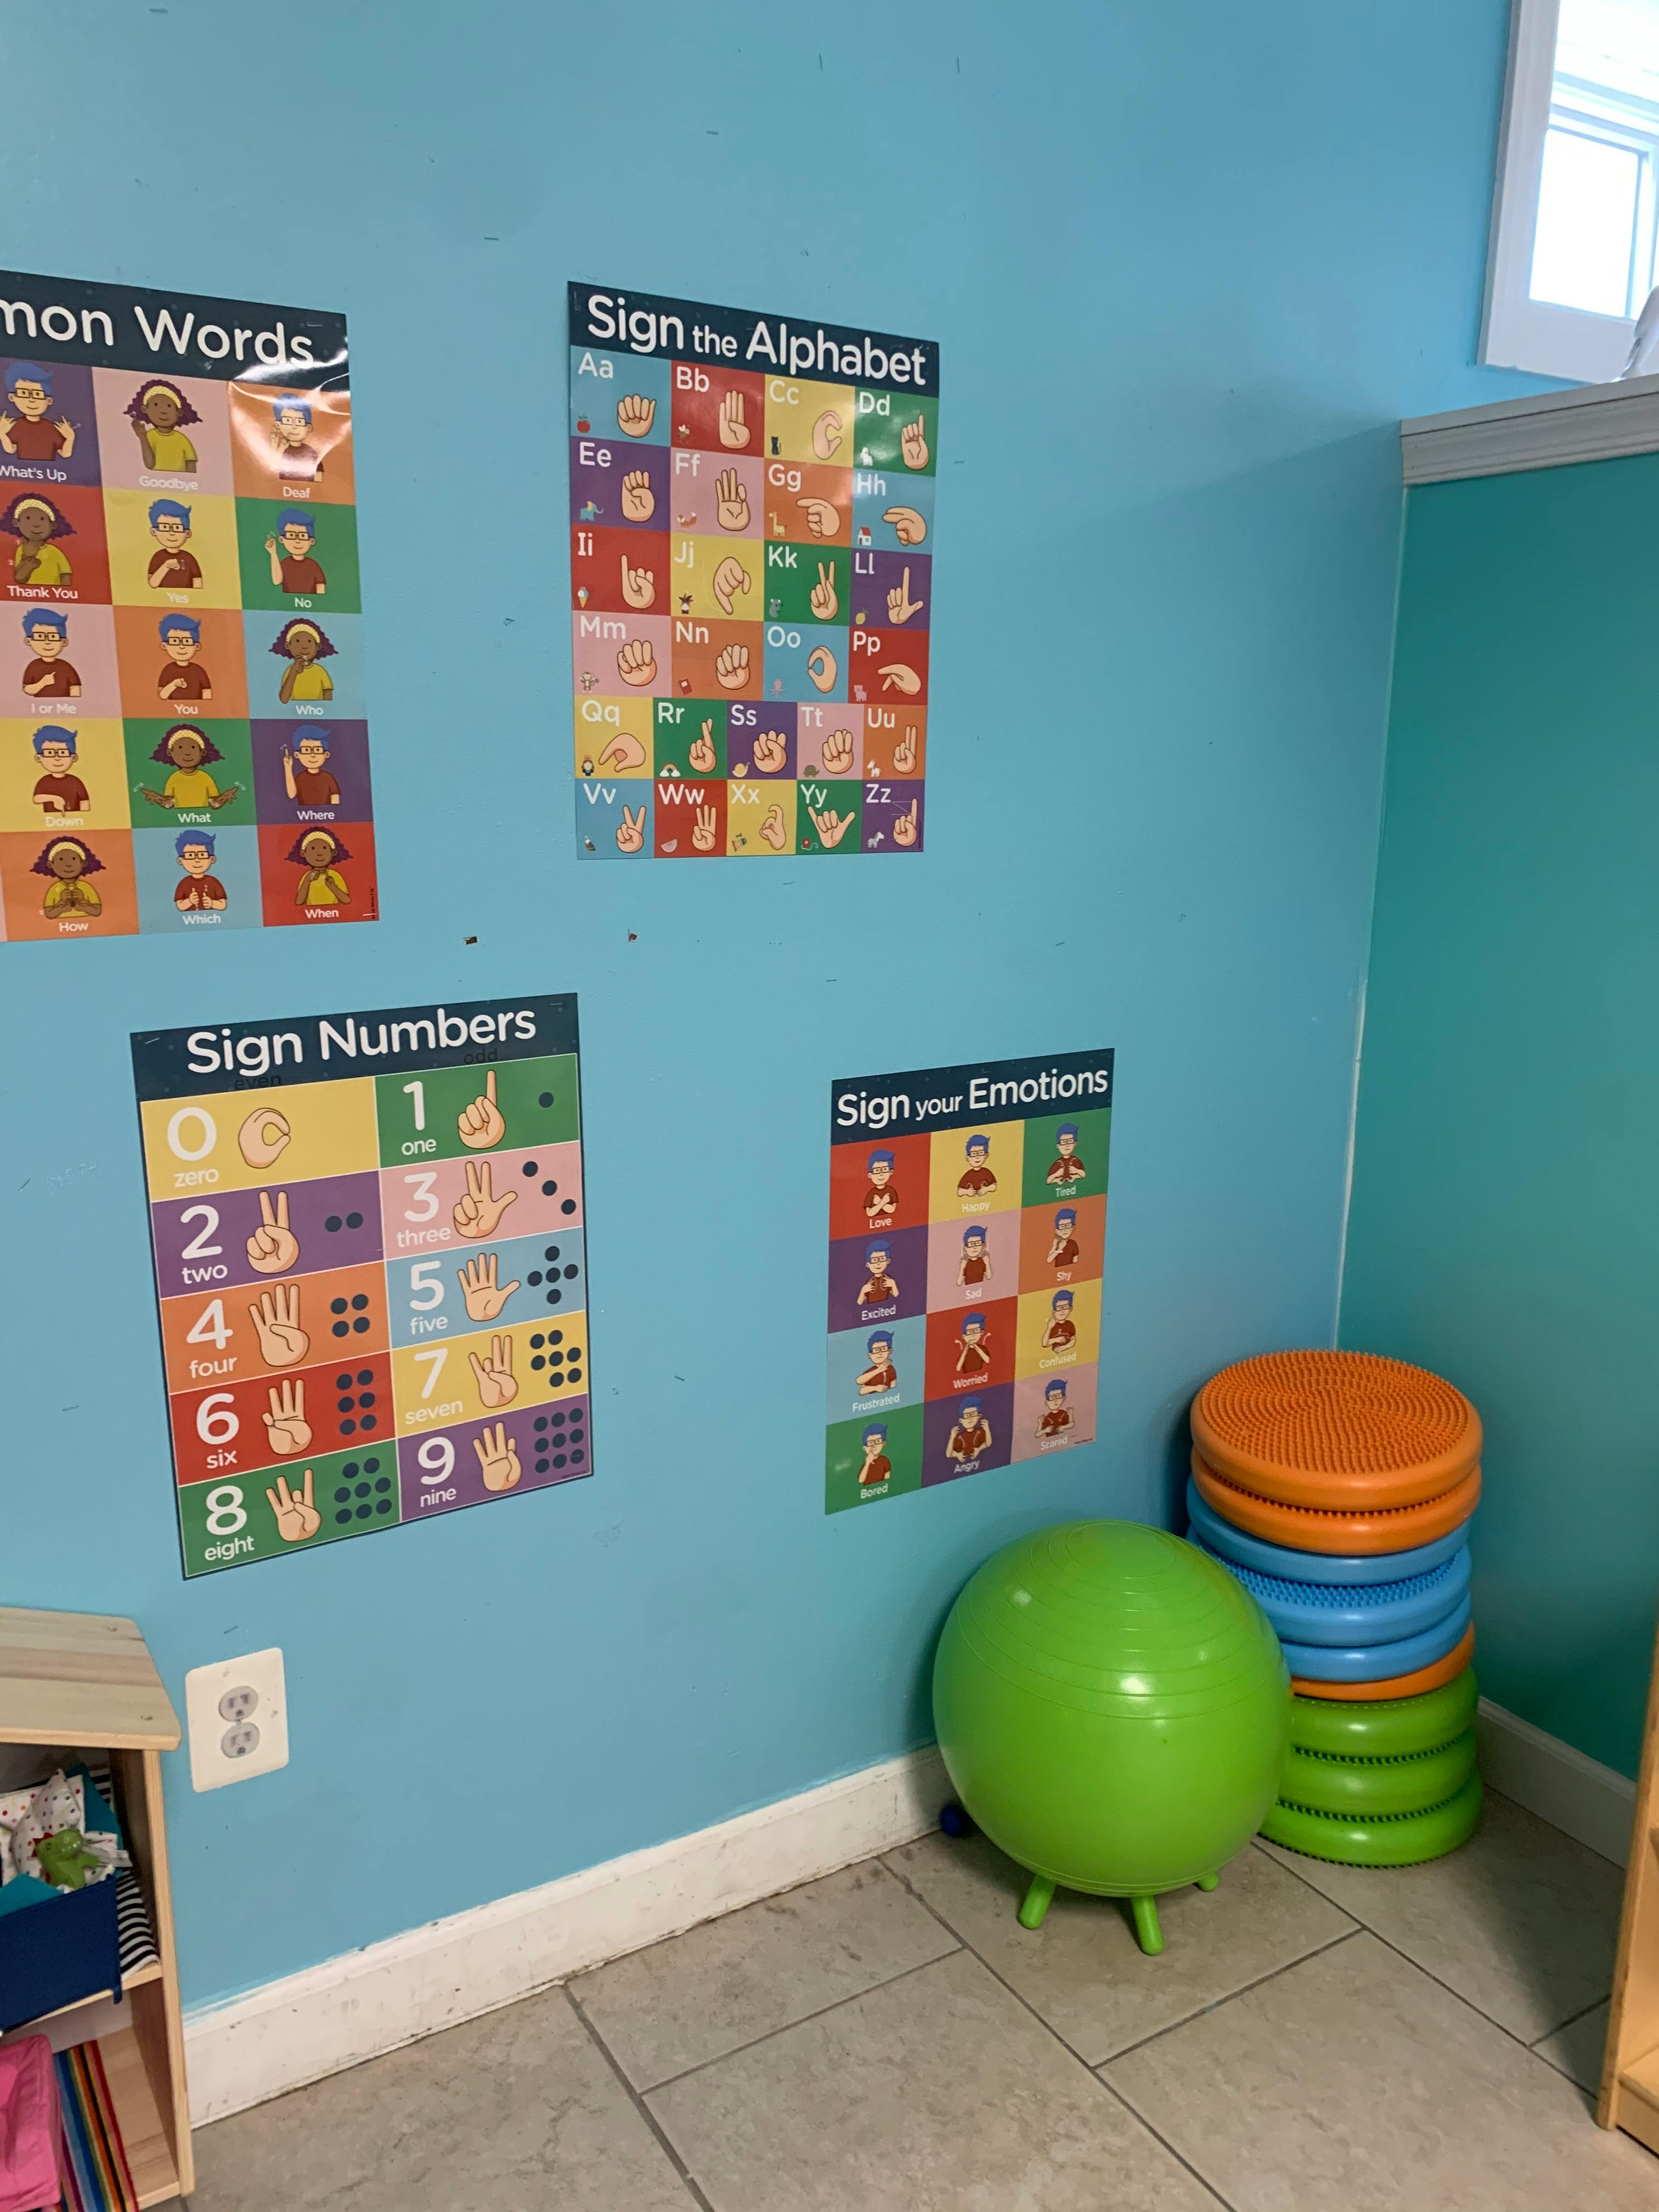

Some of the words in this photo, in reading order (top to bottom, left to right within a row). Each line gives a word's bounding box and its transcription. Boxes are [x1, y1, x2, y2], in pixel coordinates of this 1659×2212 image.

[134, 306, 314, 368] Words
[588, 295, 683, 352] Sign
[692, 325, 737, 357] the
[746, 321, 926, 385] Alphabet
[579, 352, 613, 378] Aa
[677, 366, 709, 392] Bb
[770, 380, 799, 404] Cc
[859, 392, 890, 416] Dd
[580, 442, 611, 467] Ee
[676, 453, 700, 476] Ff
[0, 466, 43, 478] What's
[47, 469, 66, 482] Up
[139, 476, 198, 491] Goodbye
[769, 464, 800, 492] Gg
[283, 487, 310, 498] Deaf
[857, 475, 885, 496] Hh
[578, 533, 592, 556] Ii
[675, 542, 693, 568] Jj
[769, 546, 797, 568] Kk
[856, 553, 874, 574] Ll
[7, 586, 49, 597] Thank
[52, 588, 78, 599] You
[168, 593, 189, 603] Yes
[295, 598, 312, 607] No
[581, 616, 625, 639] Mm
[676, 621, 708, 644] Nn
[768, 626, 800, 648] Oo
[854, 631, 880, 656] Pp
[32, 703, 35, 713] I
[57, 703, 76, 713] Me
[174, 704, 198, 714] You
[296, 706, 323, 715] Who
[582, 700, 619, 726] Qq
[658, 702, 685, 723] Rr
[731, 704, 756, 725] Ss
[801, 707, 822, 727] Tt
[868, 708, 894, 727] Uu
[584, 783, 616, 804] Vv
[658, 784, 704, 804] Ww
[732, 785, 759, 804] Xx
[801, 785, 827, 808] Yy
[866, 784, 890, 803] Zz
[46, 816, 83, 826] Down
[178, 813, 211, 822] What
[297, 811, 334, 820] Where
[183, 914, 221, 924] Which
[305, 909, 338, 918] When
[59, 922, 88, 932] How
[188, 1029, 302, 1076] Sign
[319, 1008, 535, 1060] Numbers
[464, 1047, 498, 1065] odd
[234, 1075, 281, 1089] even
[403, 1081, 425, 1130] 1
[837, 1092, 909, 1128] Sign
[916, 1096, 963, 1120] your
[970, 1069, 1107, 1109] Emotions
[167, 1107, 216, 1161] 0
[402, 1139, 436, 1155] one
[174, 1169, 219, 1187] zero
[404, 1172, 438, 1222] 3
[1056, 1186, 1076, 1197] Tired
[962, 1203, 990, 1212] Happy
[181, 1205, 222, 1259] 2
[870, 1218, 891, 1228] Love
[397, 1228, 451, 1247] three
[182, 1265, 227, 1284] two
[1057, 1272, 1071, 1280] Shy
[410, 1261, 444, 1310] 5
[966, 1288, 981, 1299] Sad
[862, 1305, 895, 1320] Excited
[187, 1299, 233, 1349] 4
[410, 1317, 448, 1334] five
[190, 1358, 237, 1378] four
[1040, 1352, 1076, 1368] Confused
[415, 1348, 448, 1398] 7
[953, 1373, 988, 1389] Worried
[405, 1401, 462, 1424] seven
[853, 1393, 899, 1412] Frustrated
[197, 1393, 239, 1444] 6
[1041, 1435, 1067, 1450] Scared
[207, 1449, 237, 1468] six
[418, 1437, 454, 1485] 9
[954, 1461, 979, 1473] Angry
[421, 1488, 456, 1507] nine
[861, 1483, 888, 1498] Bored
[206, 1486, 247, 1535] 8
[205, 1536, 255, 1560] eight
